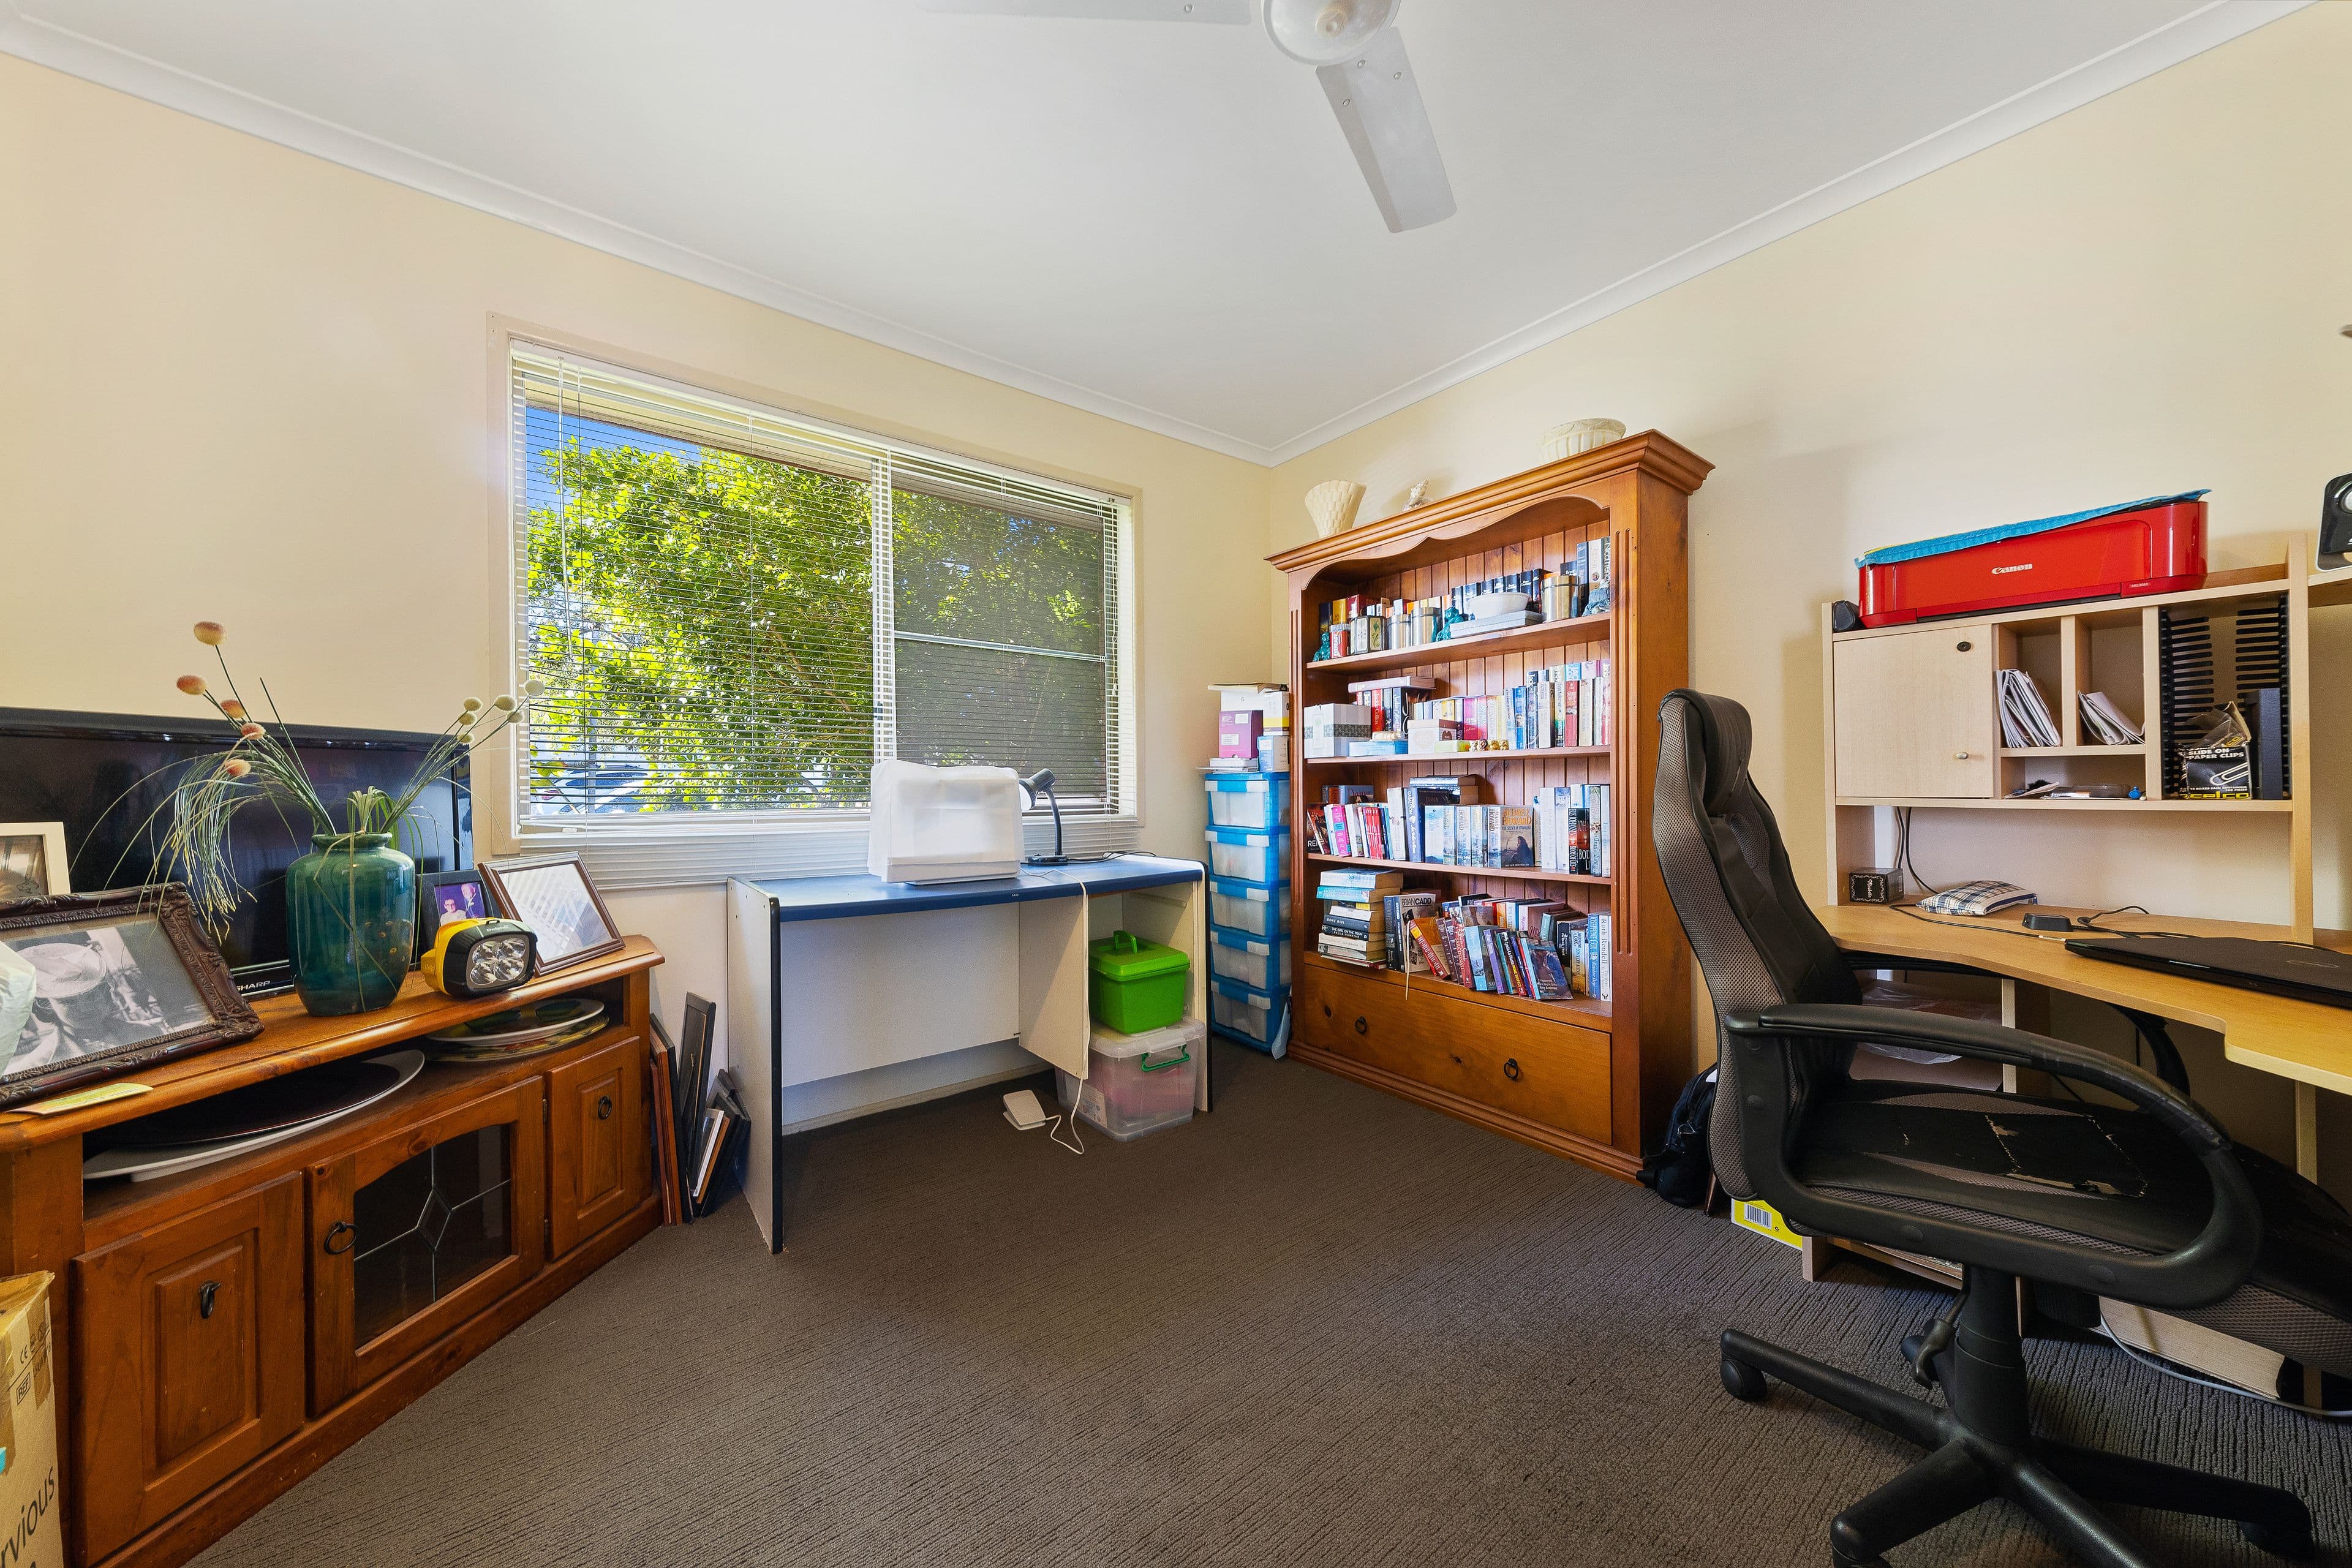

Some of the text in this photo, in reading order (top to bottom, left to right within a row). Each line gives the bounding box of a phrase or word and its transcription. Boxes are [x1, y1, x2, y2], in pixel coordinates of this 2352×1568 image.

[1991, 563, 2033, 575] Canon
[1502, 816, 1532, 826] HOWARD
[1568, 816, 1577, 836] JOHANSEN
[1588, 916, 1598, 940] JOSEPHINE
[1588, 940, 1598, 949] COX
[236, 981, 271, 991] SHARP
[18, 1379, 29, 1400] REF
